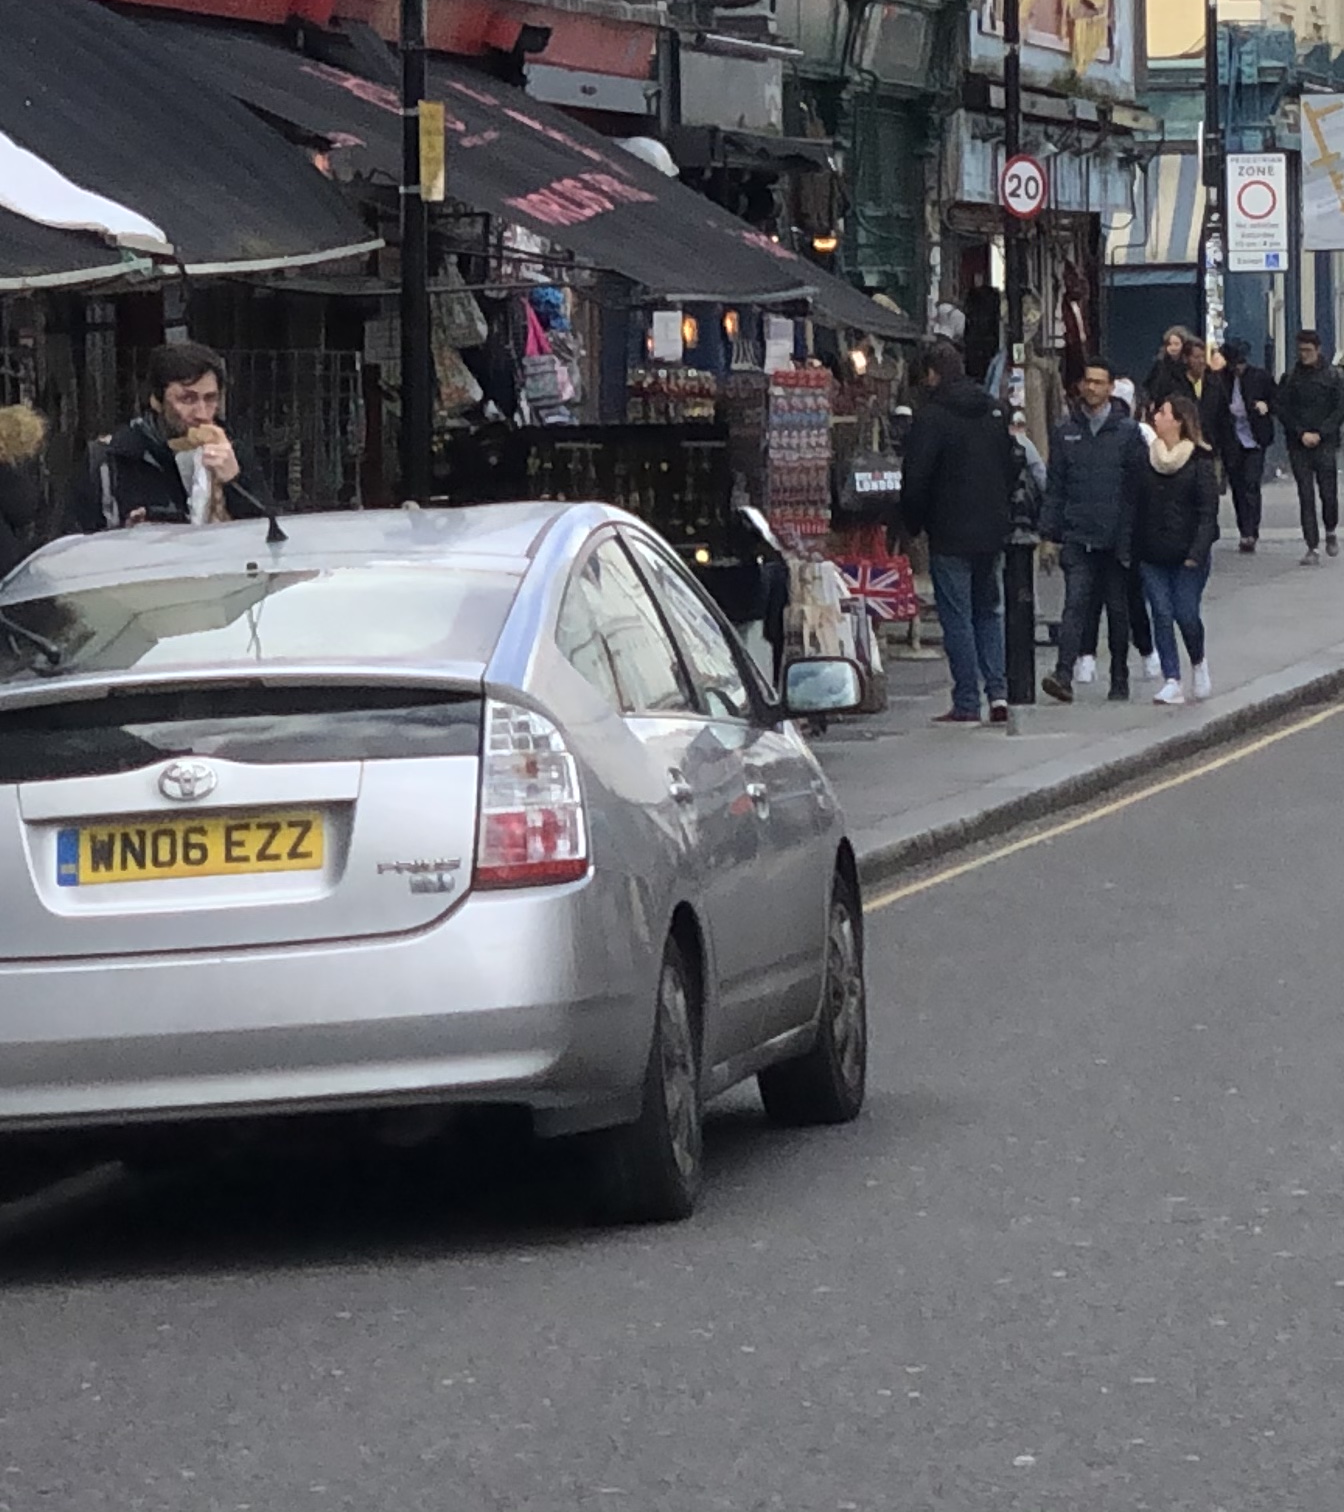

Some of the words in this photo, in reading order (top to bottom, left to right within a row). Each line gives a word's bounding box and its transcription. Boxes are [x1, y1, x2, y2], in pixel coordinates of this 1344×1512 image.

[1238, 166, 1275, 176] ZONE
[1008, 173, 1040, 200] 20
[90, 826, 208, 873] WN06
[224, 820, 313, 864] EZZ
